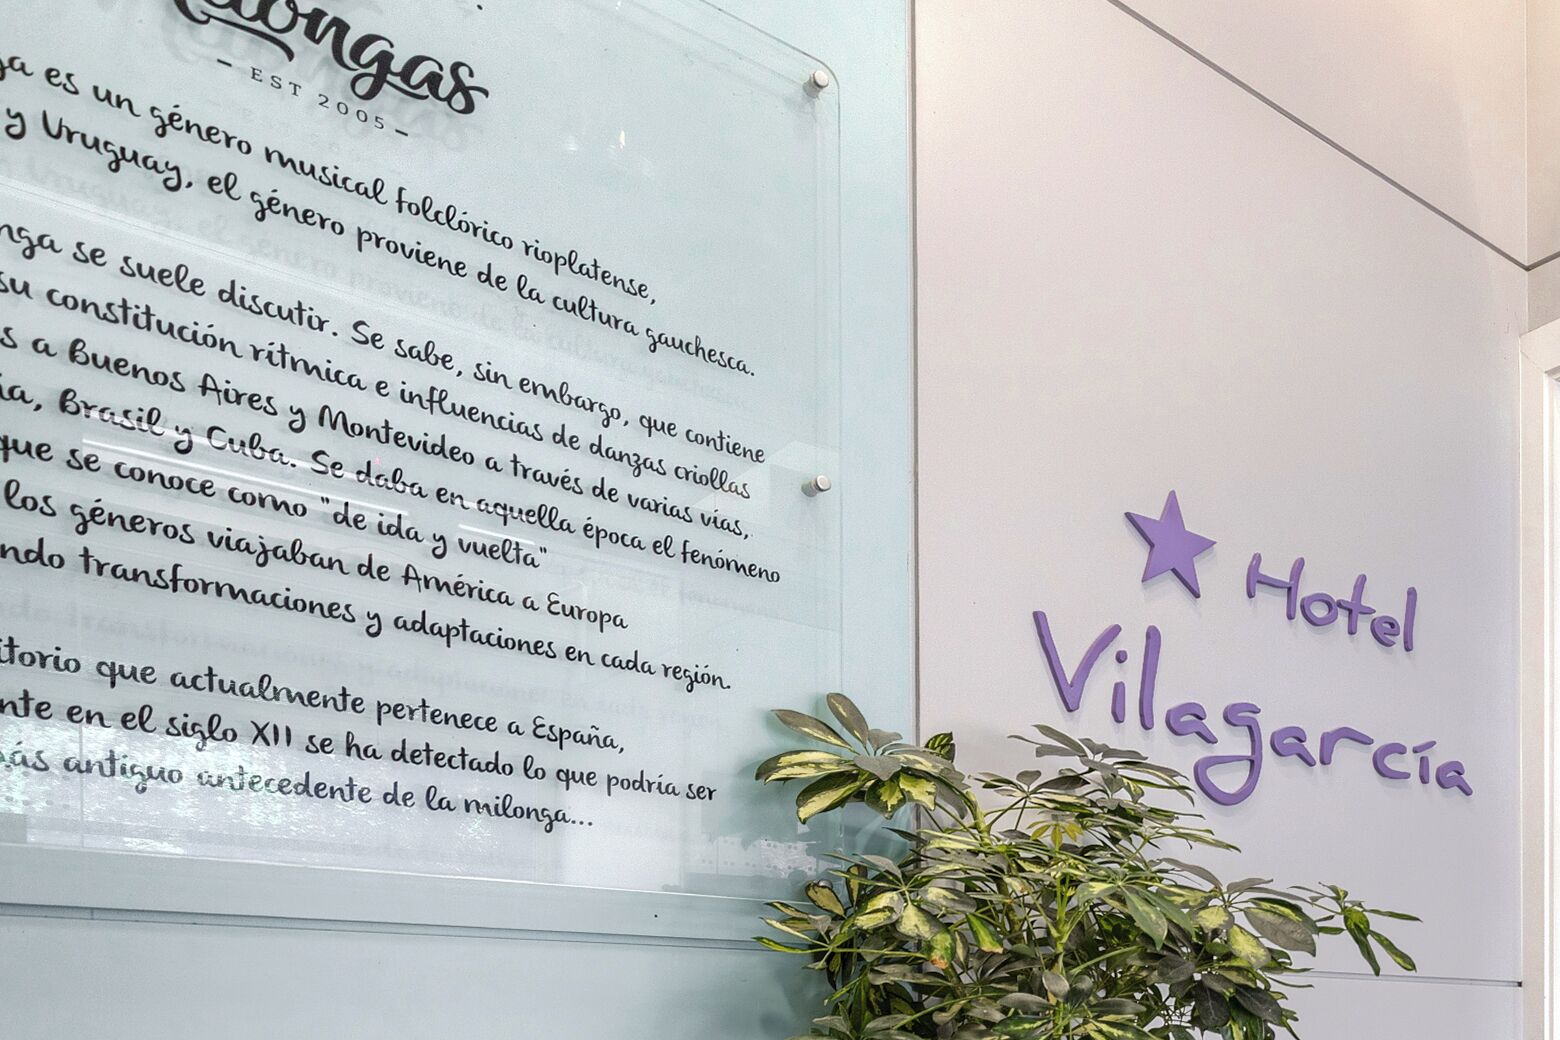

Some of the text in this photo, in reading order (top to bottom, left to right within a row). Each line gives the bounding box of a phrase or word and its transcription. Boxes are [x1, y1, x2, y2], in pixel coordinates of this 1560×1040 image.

[173, 0, 489, 115] ongas
[251, 67, 384, 129] EST 2005
[5, 106, 754, 376] y Uruguay, el género proviene de la cultura gauchesca.
[44, 67, 656, 305] es un género musical folclórico rioplatense,
[46, 286, 246, 366] constitución
[249, 342, 367, 391] rítmica
[375, 380, 390, 397] e
[400, 378, 543, 441] influencias
[552, 424, 580, 450] de
[589, 434, 667, 477] danzas
[674, 465, 750, 499] criollas
[72, 241, 107, 267] se
[119, 256, 206, 296] suele
[218, 279, 338, 336] discutir.
[351, 320, 384, 350] Se
[394, 339, 462, 377] sabe,
[473, 361, 513, 389] sin
[519, 378, 629, 428] embargo,
[639, 415, 678, 437] que
[685, 429, 765, 463] contiene
[65, 449, 101, 472] se
[114, 462, 216, 497] conoce
[228, 487, 307, 517] como
[321, 497, 367, 530] "de
[377, 513, 424, 543] ida
[432, 533, 447, 559] y
[458, 538, 547, 568] vuelta"
[1246, 552, 1418, 652] Hotel
[66, 705, 111, 728] en
[120, 704, 157, 733] el
[165, 713, 238, 752] siglo
[250, 721, 291, 747] XII
[305, 735, 334, 754] se
[345, 731, 383, 760] ha
[391, 738, 514, 776] detectado
[523, 755, 546, 780] lo
[556, 769, 597, 791] que
[607, 770, 680, 797] podría
[686, 784, 717, 800] ser
[96, 661, 157, 689] que
[170, 666, 365, 718] actualmente
[377, 698, 498, 732] pertenece
[507, 721, 525, 736] a
[532, 716, 624, 754] España,
[1032, 610, 1473, 807] Vilagarcía
